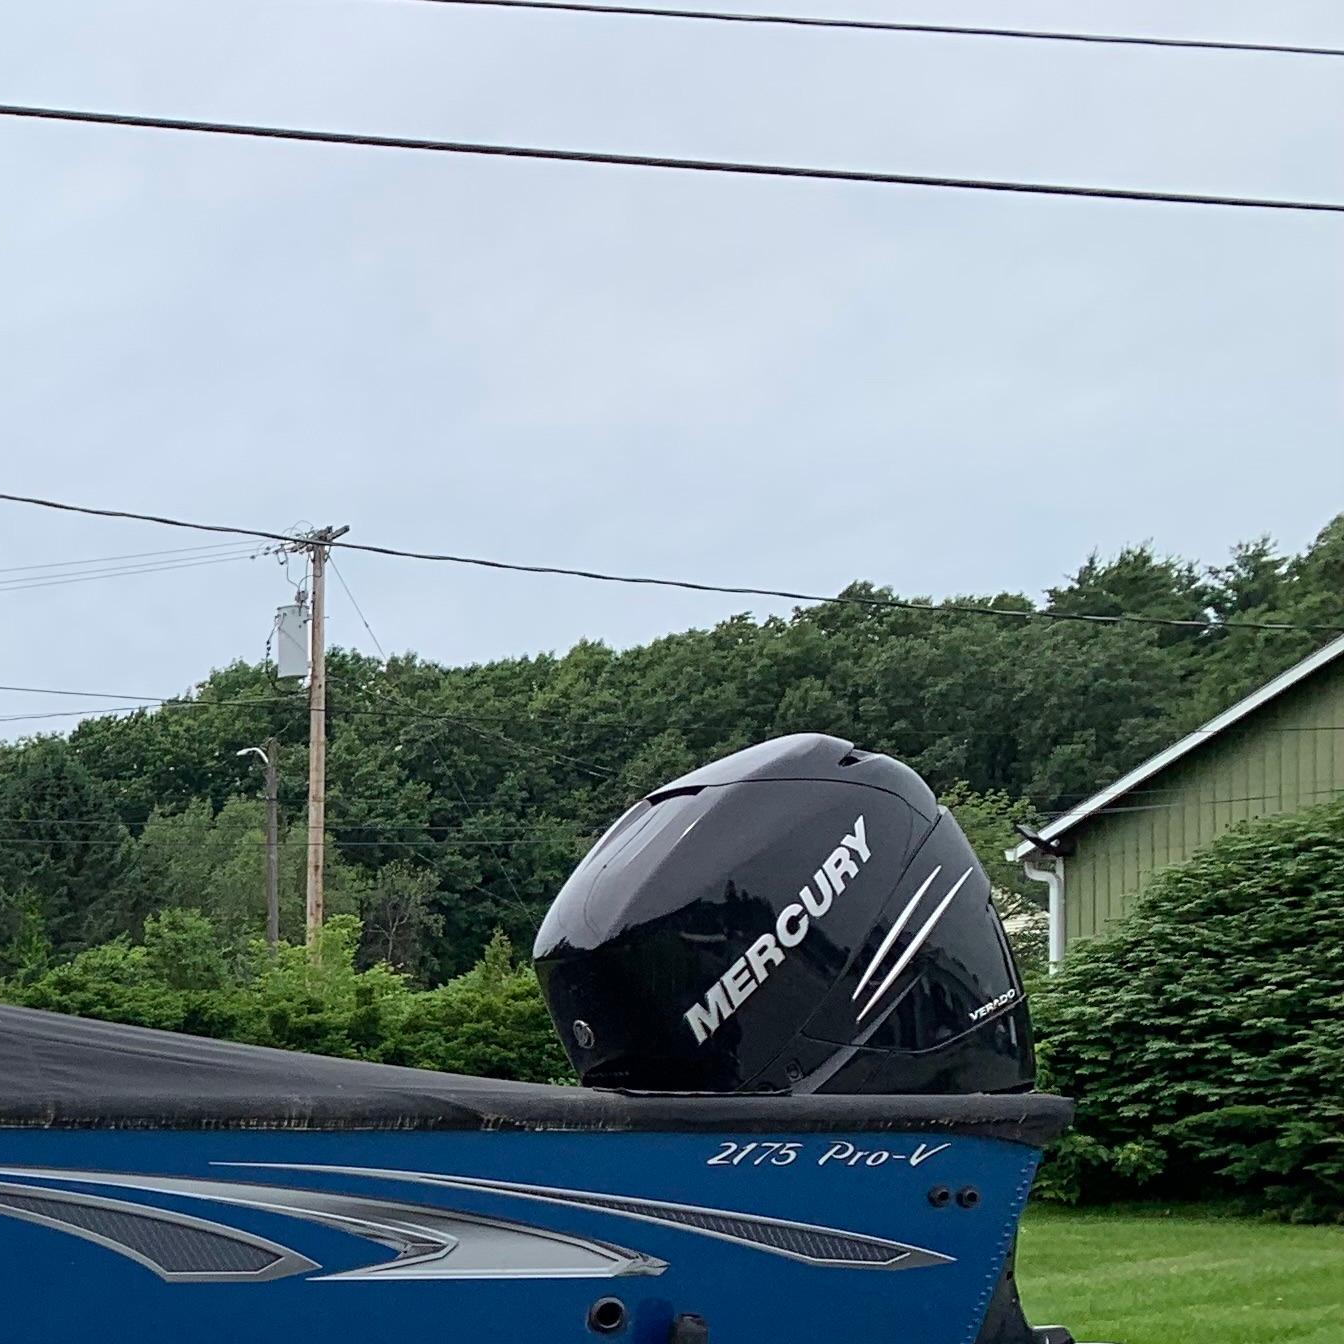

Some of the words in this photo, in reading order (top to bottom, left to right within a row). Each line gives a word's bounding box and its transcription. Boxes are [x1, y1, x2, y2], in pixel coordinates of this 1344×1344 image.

[683, 814, 873, 1047] MERCURY
[968, 988, 1016, 1021] VERADO
[706, 1141, 805, 1167] 2175
[817, 1140, 953, 1167] Pro-V
